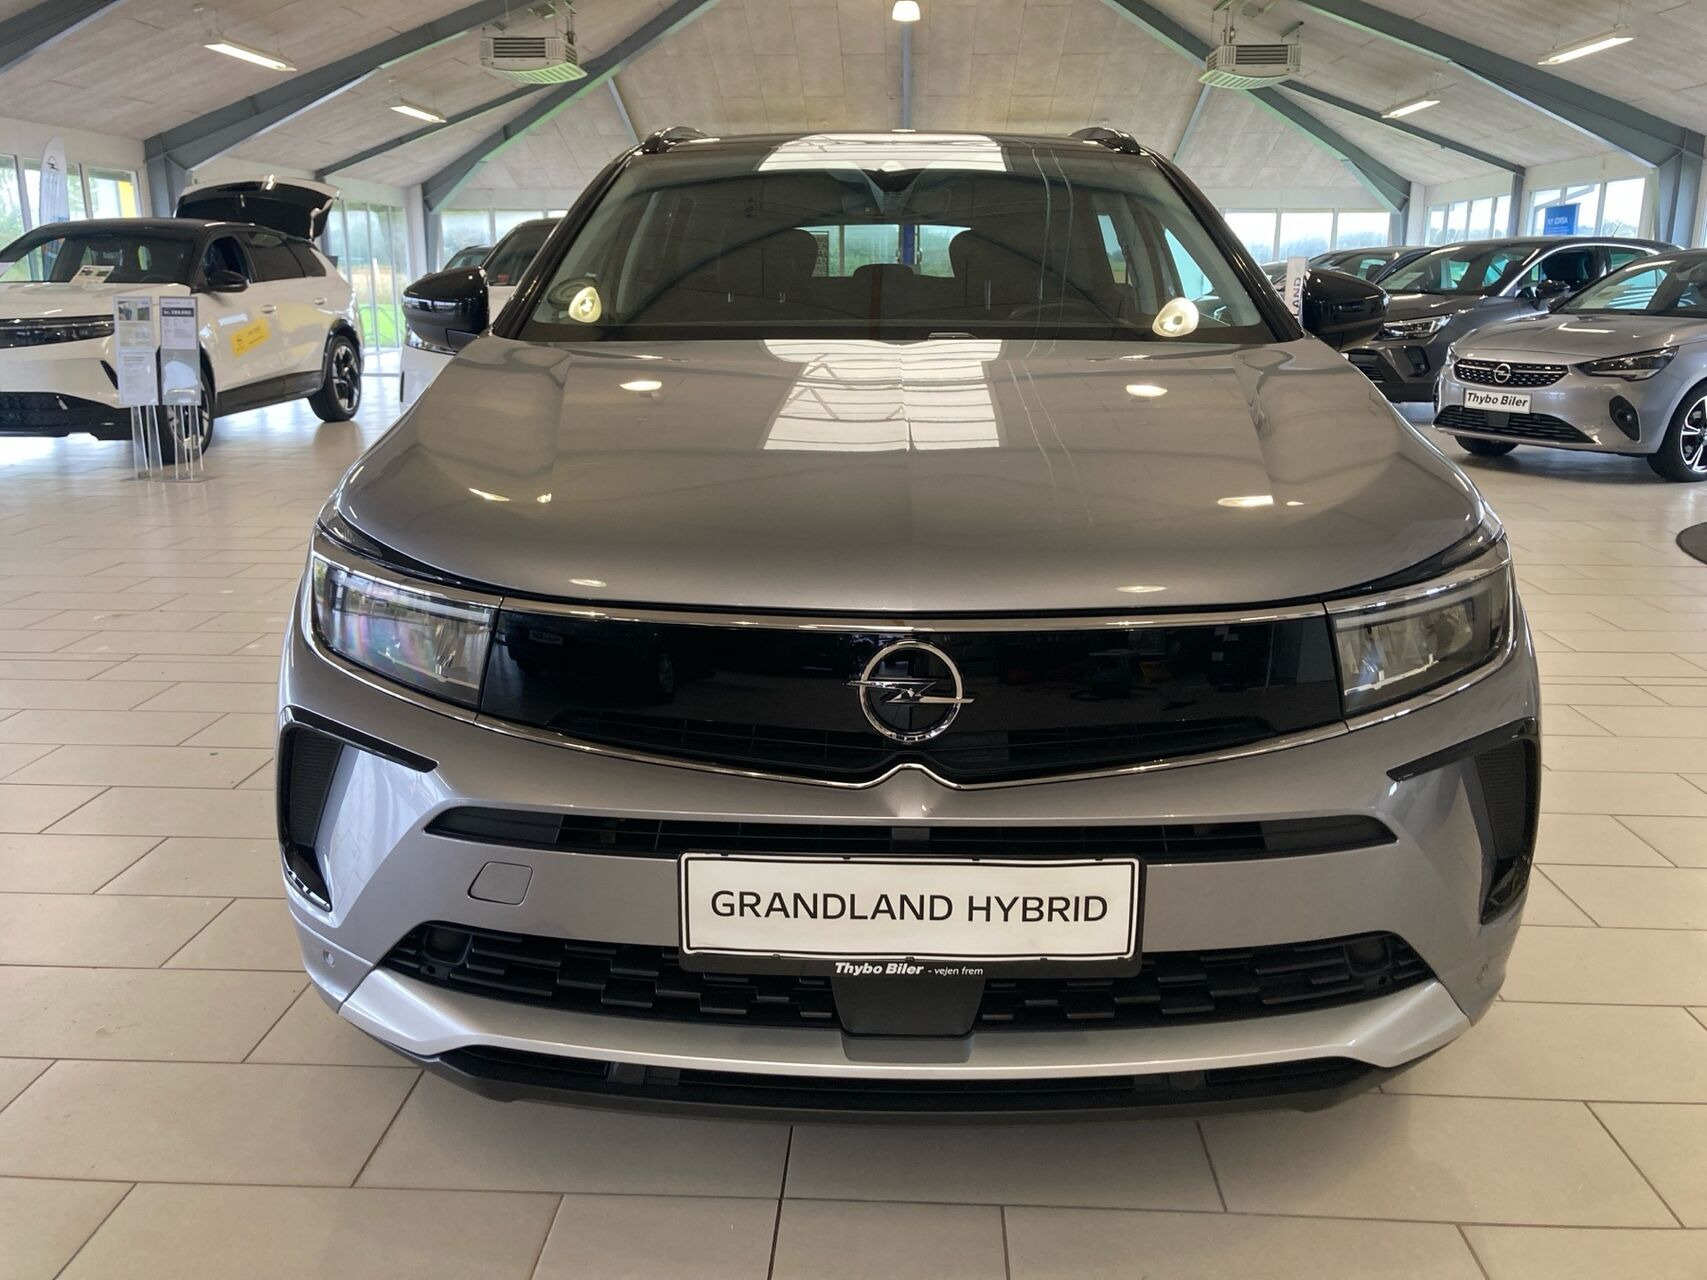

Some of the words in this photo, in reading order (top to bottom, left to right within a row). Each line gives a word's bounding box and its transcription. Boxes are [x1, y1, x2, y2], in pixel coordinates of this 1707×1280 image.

[1292, 277, 1301, 318] LAND
[1467, 392, 1498, 405] Thybo
[1500, 395, 1528, 407] Biler
[711, 890, 953, 921] GRANDLAND
[968, 895, 1108, 922] HYBRID
[835, 962, 883, 976] Thybo
[885, 963, 925, 975] Biler
[934, 967, 960, 977] vejen
[961, 966, 984, 976] frem
